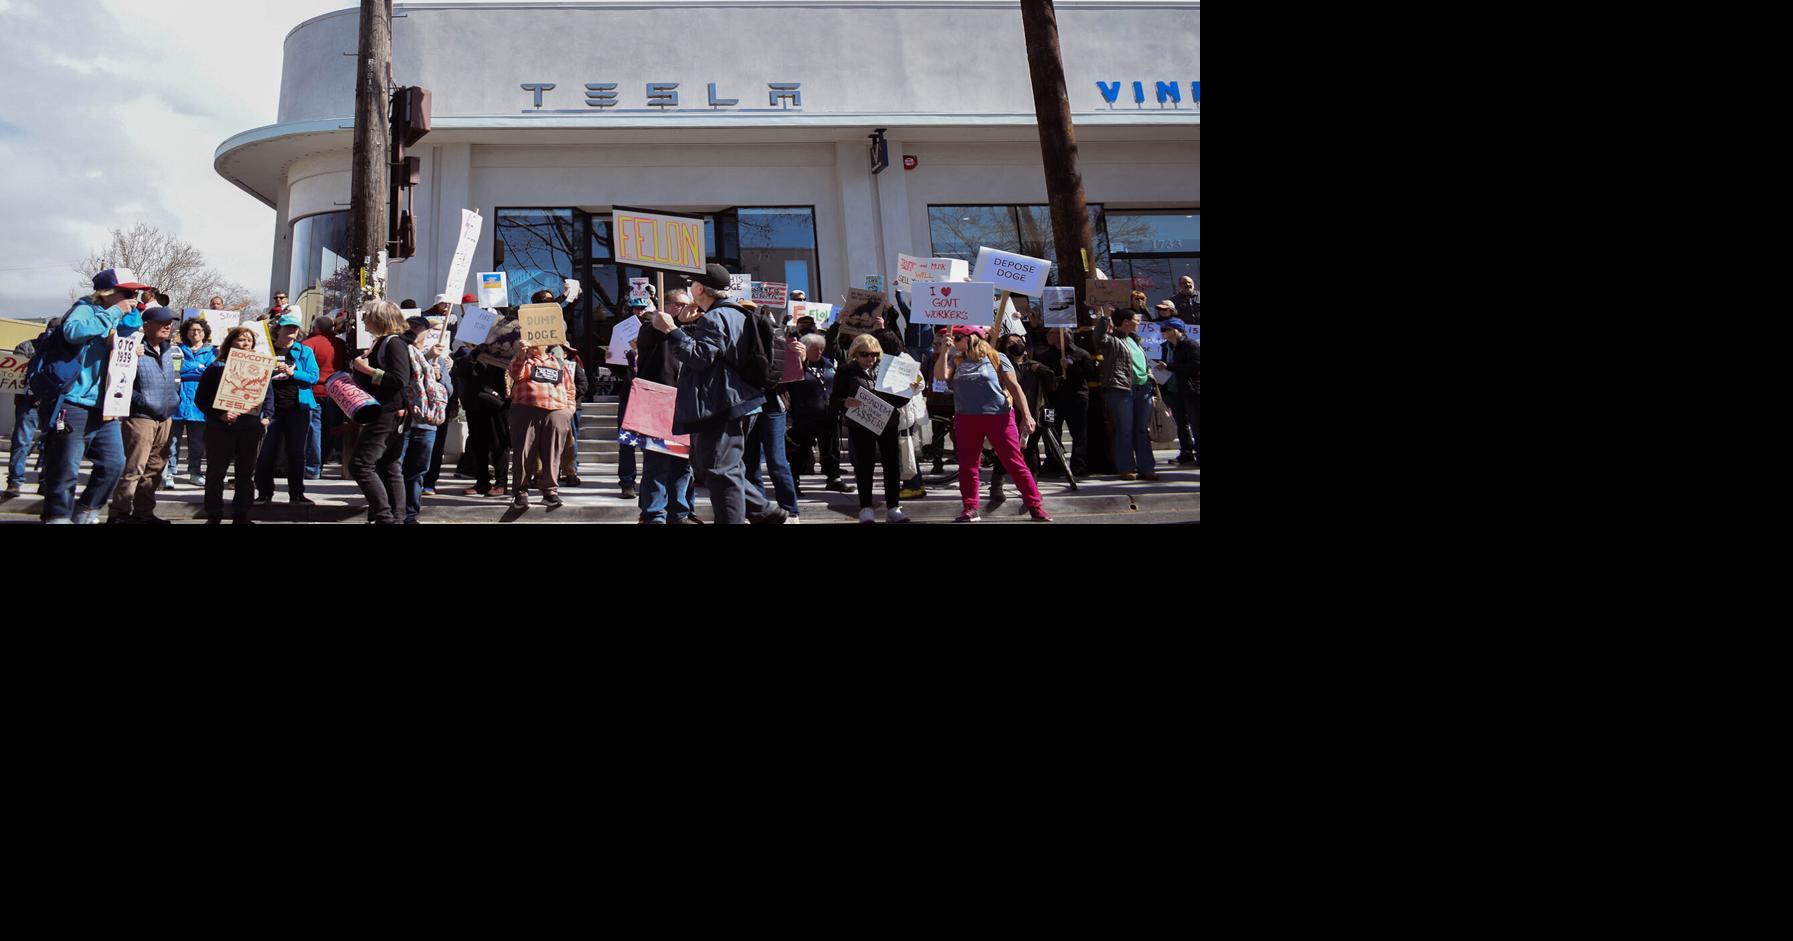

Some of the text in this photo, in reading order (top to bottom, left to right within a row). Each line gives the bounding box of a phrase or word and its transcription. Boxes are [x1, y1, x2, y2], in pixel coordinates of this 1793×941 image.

[520, 83, 801, 106] TESLA
[618, 216, 700, 269] FELON
[994, 257, 1035, 273] DEPOSE
[997, 268, 1026, 282] DOGE
[930, 286, 936, 296] I
[932, 298, 960, 308] GOVT
[527, 315, 556, 325] DUMP
[925, 309, 968, 320] WORKERS
[528, 330, 557, 340] DOGE
[116, 351, 131, 363] 1939
[231, 350, 273, 364] BOYCOTT
[0, 378, 26, 389] FAS
